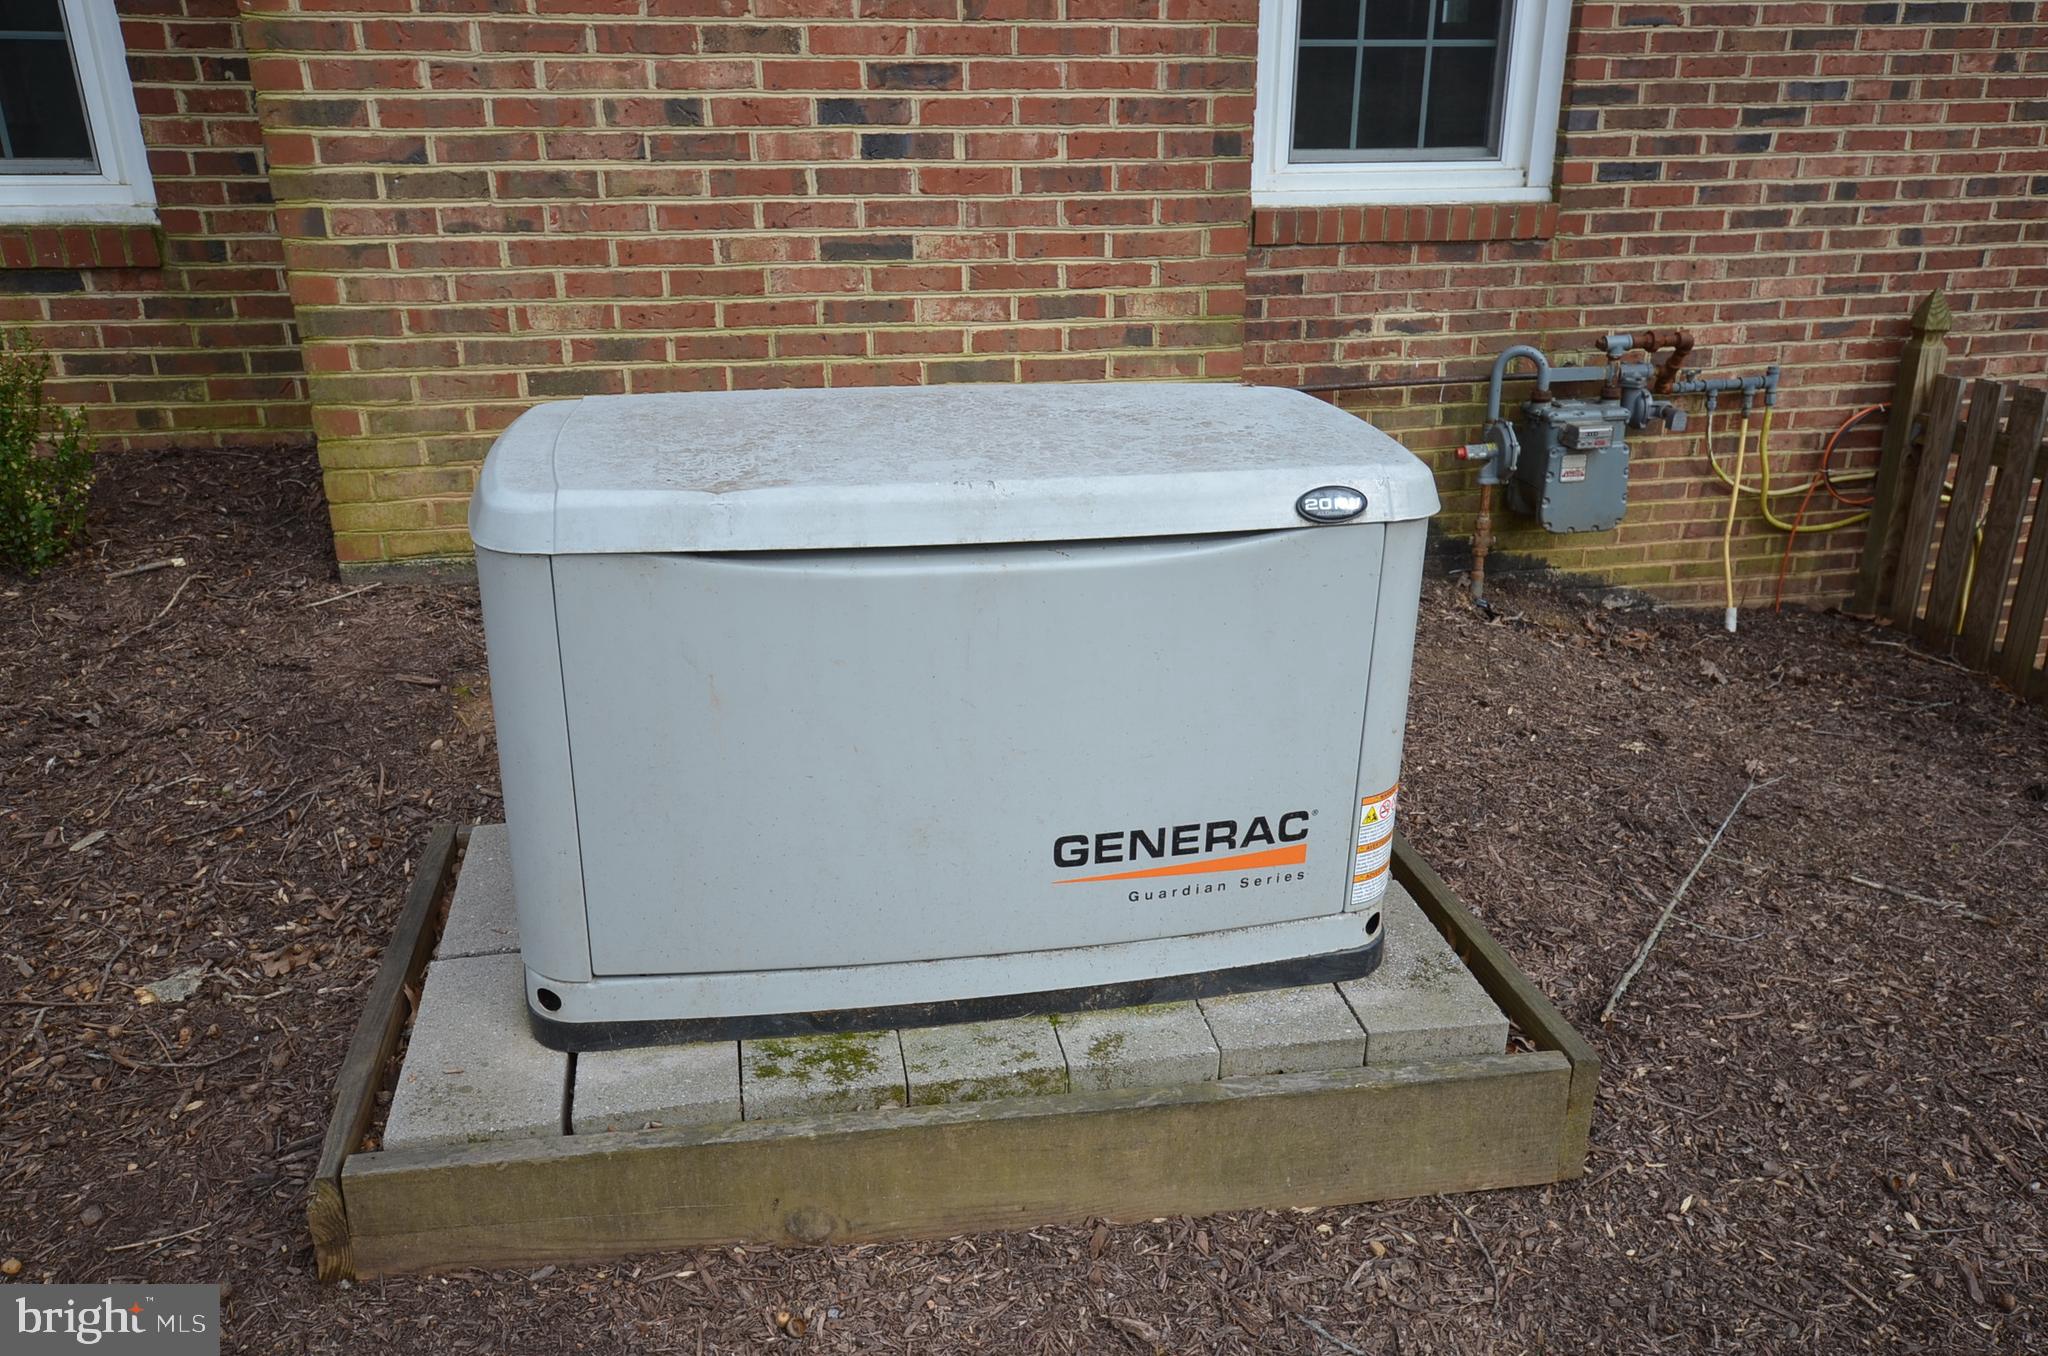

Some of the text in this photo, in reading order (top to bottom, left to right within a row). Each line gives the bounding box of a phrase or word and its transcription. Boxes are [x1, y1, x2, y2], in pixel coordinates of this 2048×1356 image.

[1304, 498, 1332, 511] 20
[1053, 811, 1309, 868] GENERAC
[1128, 870, 1305, 902] Guardian Series
